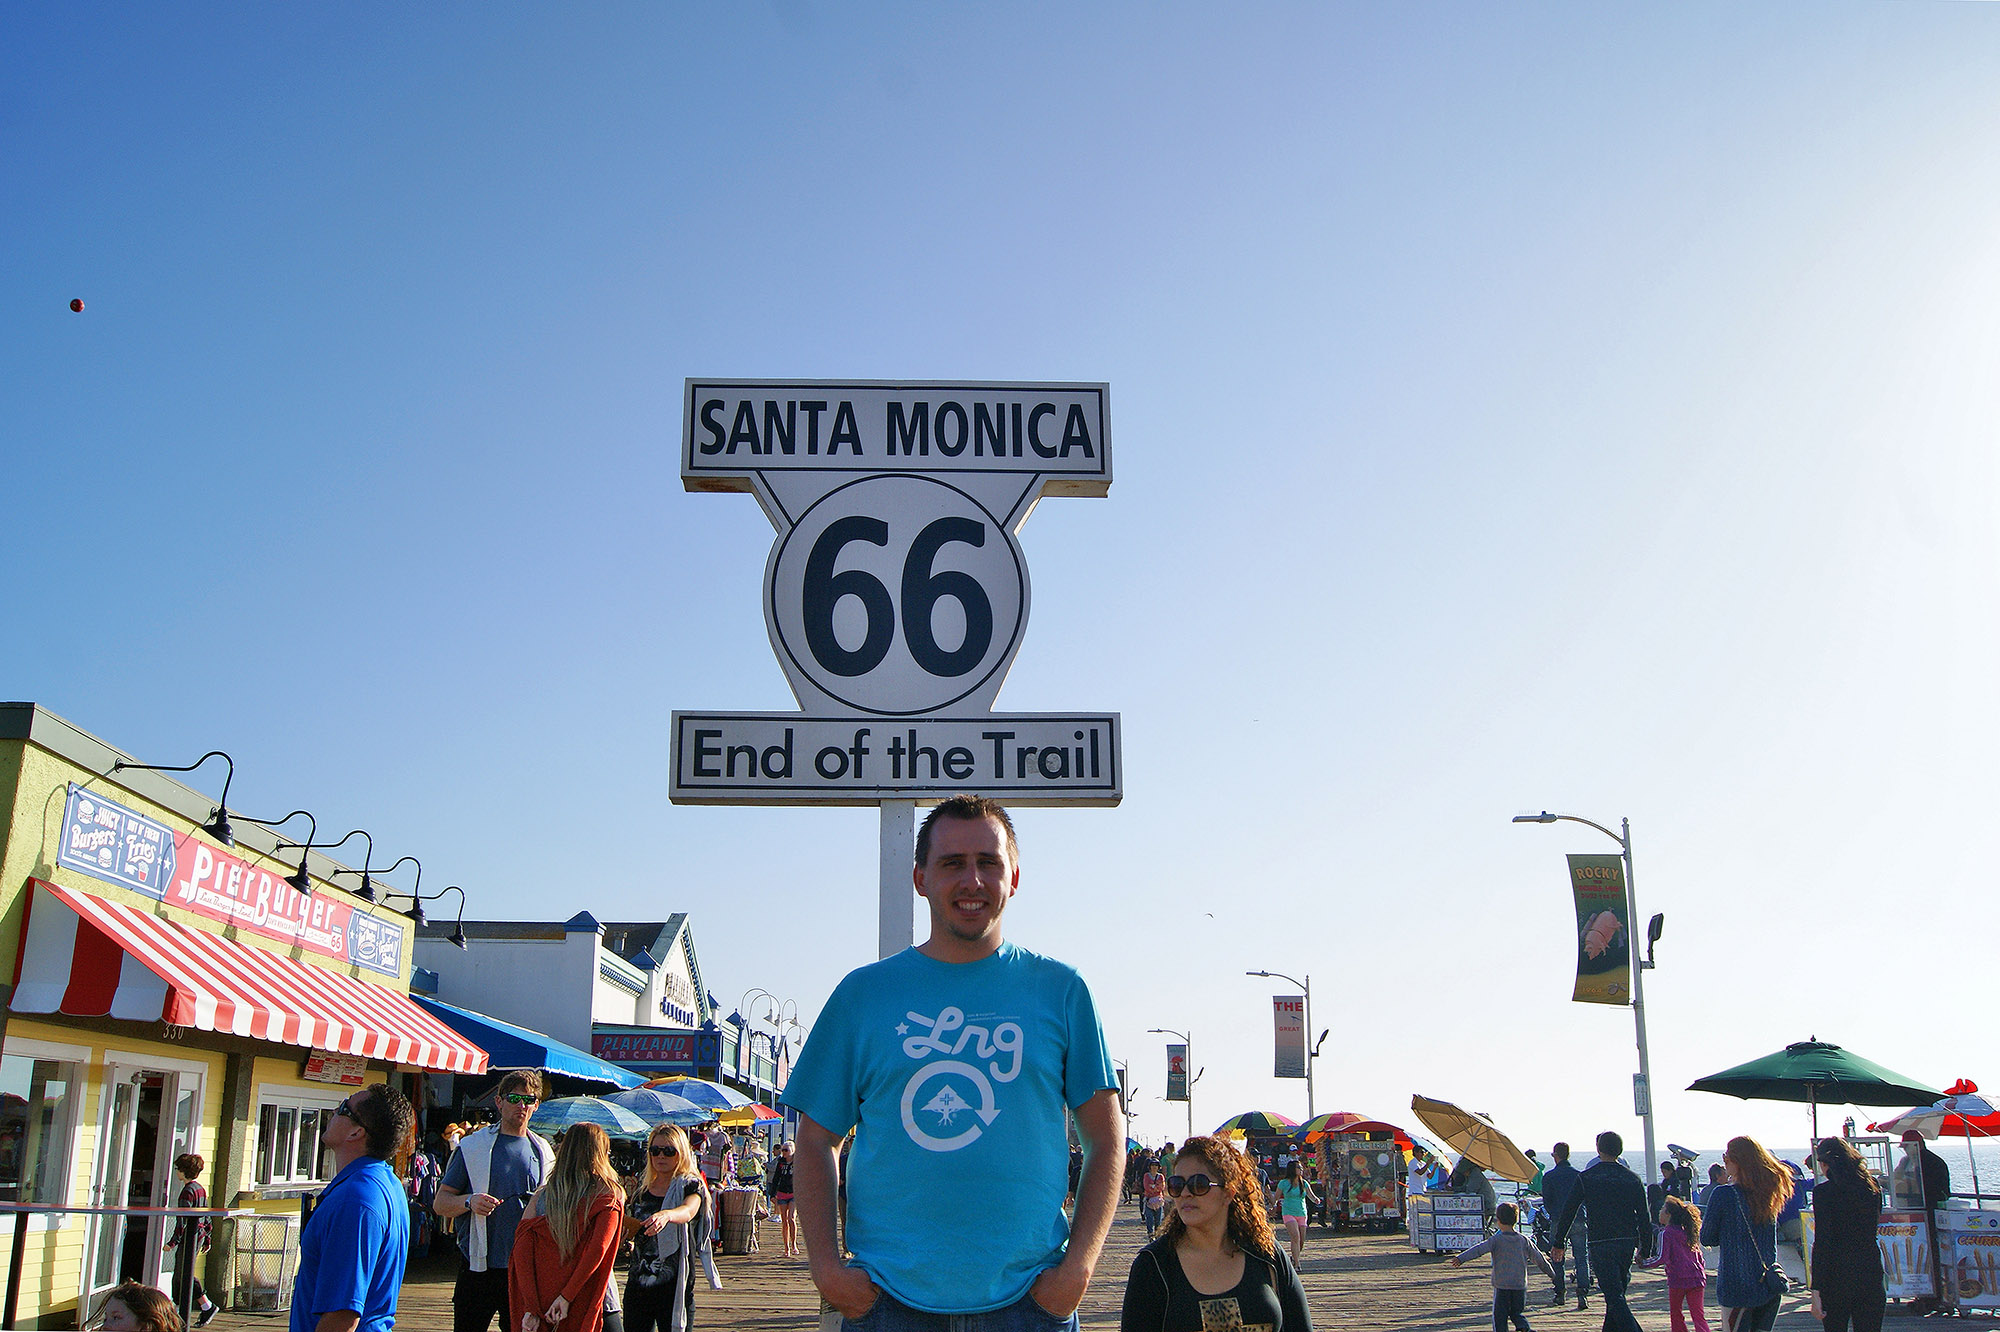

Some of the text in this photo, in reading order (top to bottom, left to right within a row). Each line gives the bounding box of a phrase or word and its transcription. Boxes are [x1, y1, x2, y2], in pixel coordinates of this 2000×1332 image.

[699, 398, 1095, 459] SANTA MONICA
[803, 515, 993, 677] 66
[693, 728, 1100, 780] End of the Trail
[94, 807, 120, 830] JUICY
[71, 824, 116, 851] Burgers
[126, 834, 157, 864] Fries
[1575, 866, 1620, 881] ROCKY
[331, 935, 341, 949] 66
[1274, 1001, 1303, 1011] THE
[163, 1023, 184, 1040] 330
[602, 1036, 686, 1051] PLAYLAND
[604, 1051, 681, 1059] ARCADE
[1877, 1226, 1918, 1237] URROS
